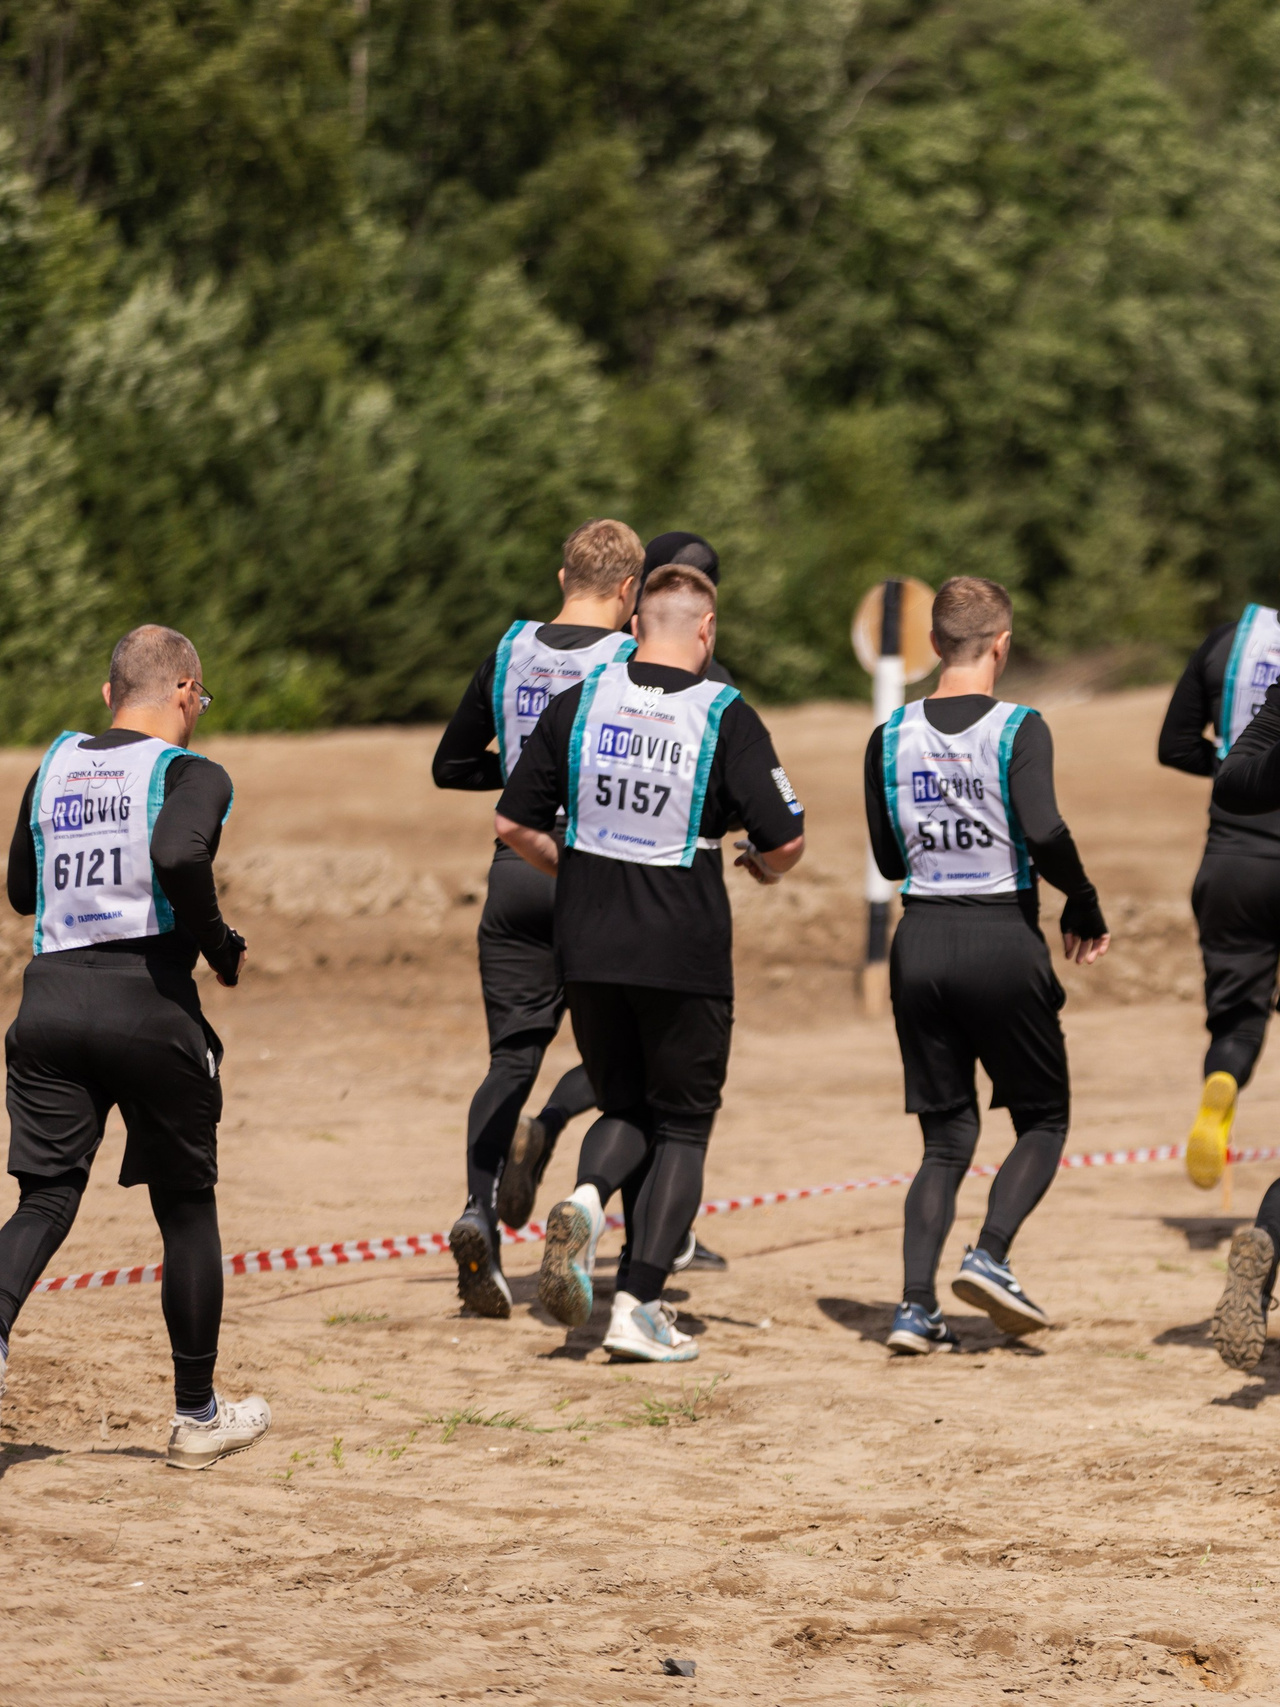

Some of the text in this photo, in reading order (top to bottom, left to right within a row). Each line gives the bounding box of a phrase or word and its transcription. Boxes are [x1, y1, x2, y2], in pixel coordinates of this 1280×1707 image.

[599, 725, 682, 765] RODVIG
[68, 770, 125, 779] ГОНКА ГЕРОЕВ
[913, 774, 985, 801] RODVIG
[596, 774, 672, 817] 5157
[53, 795, 132, 829] RODVIG
[610, 832, 657, 847] ГАЗПРОМБАНК
[918, 818, 994, 850] 5163
[54, 847, 123, 891] 6121
[77, 910, 123, 923] ГАЗПРОМБАНК
